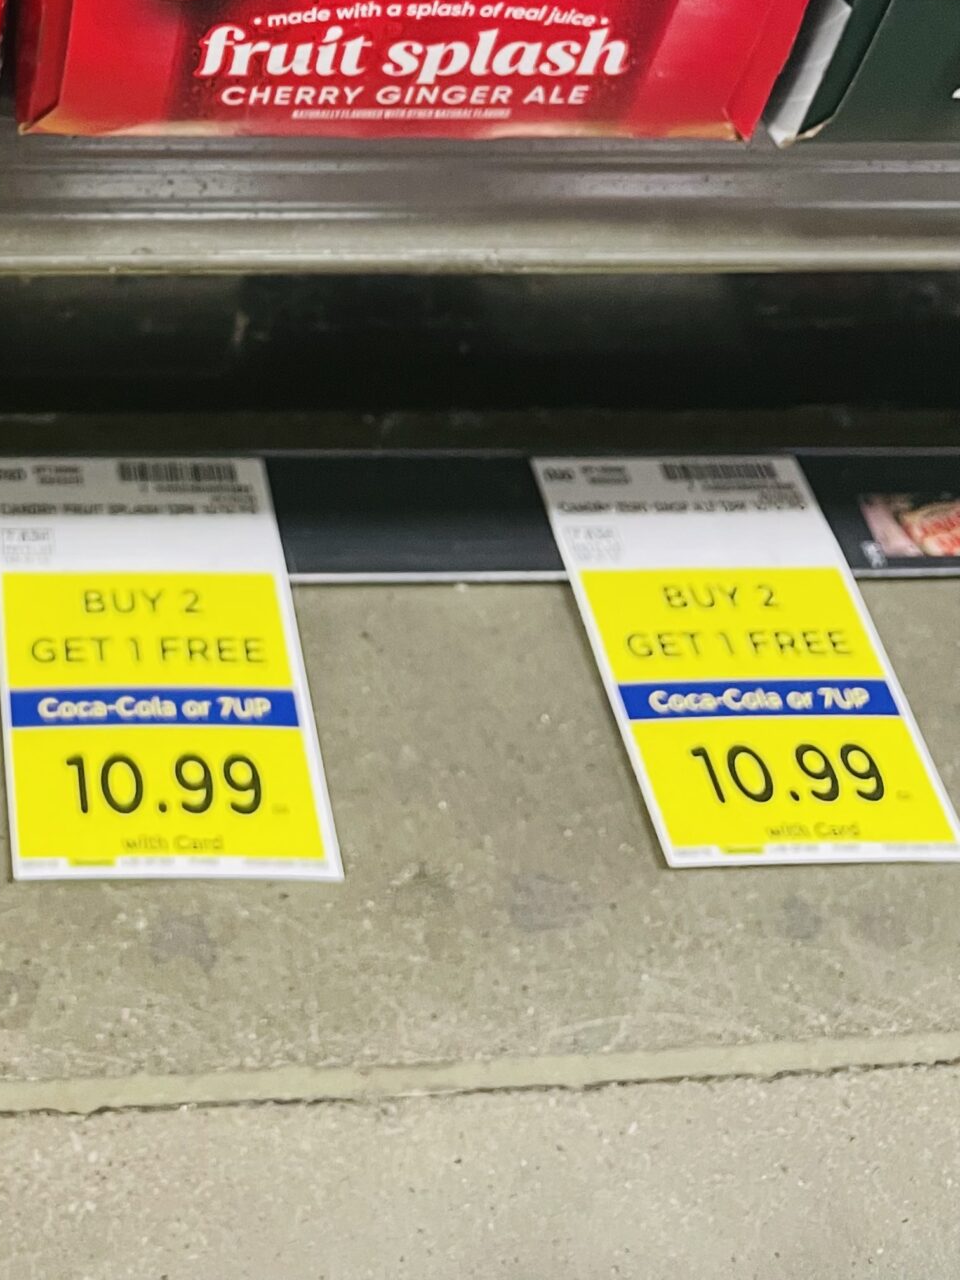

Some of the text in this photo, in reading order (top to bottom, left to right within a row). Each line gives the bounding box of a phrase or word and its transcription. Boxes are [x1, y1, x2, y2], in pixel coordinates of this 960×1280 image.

[267, 0, 596, 27] made with a splash of real juice
[199, 25, 628, 84] fruit splash
[220, 85, 591, 106] CHERRY GINGER ALE
[83, 589, 204, 613] BUY 2
[663, 583, 778, 609] BUY 2
[31, 636, 266, 663] GET 1 FREE
[626, 630, 853, 658] GET 1 FREE
[37, 695, 272, 719] Coca-Cola or 7UP
[647, 687, 871, 713] Coca-Cola or 7UP
[65, 753, 263, 815] 10.99
[690, 743, 886, 804] 10.99
